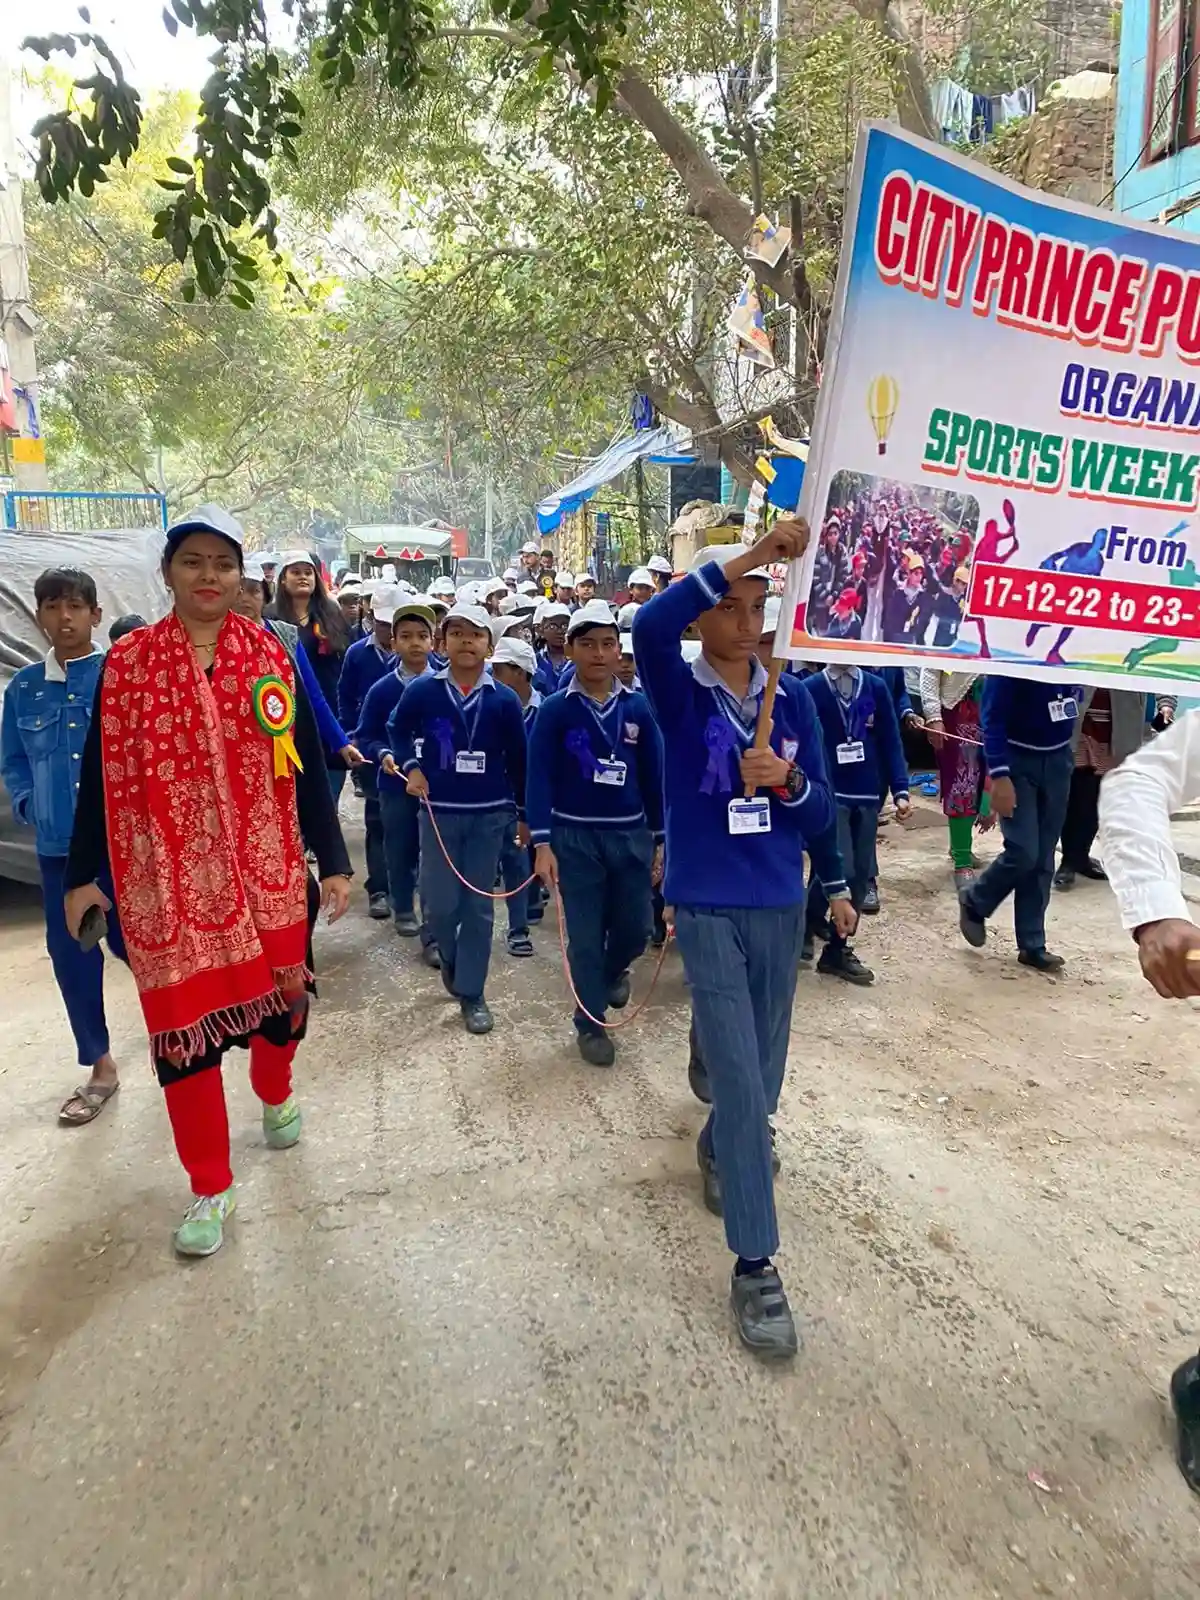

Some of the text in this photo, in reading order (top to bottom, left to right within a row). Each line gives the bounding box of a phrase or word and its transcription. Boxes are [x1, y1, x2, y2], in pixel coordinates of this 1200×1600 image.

[876, 173, 980, 296] CITY
[973, 217, 1145, 342] PRINCE
[924, 407, 1200, 504] SPORTS WEEK
[1105, 525, 1188, 568] From
[983, 575, 1200, 627] 17-12-22 to 23-
